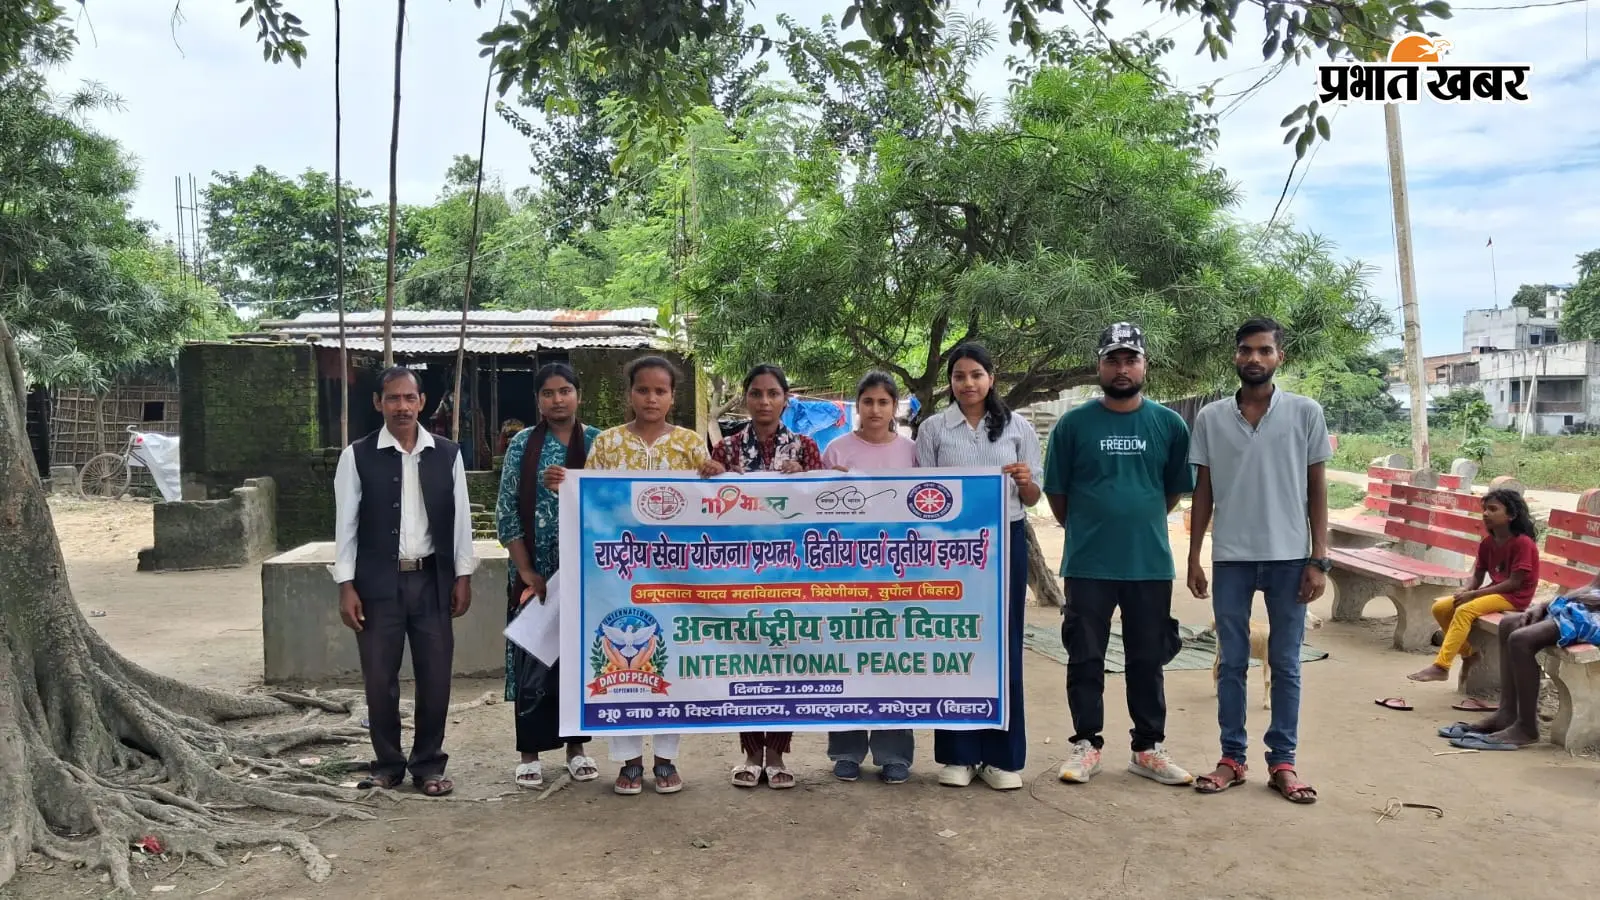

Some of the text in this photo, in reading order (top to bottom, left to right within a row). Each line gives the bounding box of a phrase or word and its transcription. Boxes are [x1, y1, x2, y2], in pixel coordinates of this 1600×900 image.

[1100, 439, 1147, 451] FREEDOM
[594, 528, 989, 578] राष्ट्रीय सेवा योजना प्रथम, द्वितीय एवं तृतीय इकाई
[635, 582, 961, 603] अनूपलाल यादव महाविद्यालय, त्रिवेणीगंज, सुपौल (बिहार)
[673, 607, 982, 648] अन्तर्राष्ट्रीय शांति दिवस
[678, 651, 975, 679] INTERNATIONAL PEACE DAY
[600, 672, 660, 687] DAY OF PEACE
[785, 684, 843, 694] 21.09.2026
[685, 702, 790, 718] विश्वविद्यालय,
[795, 702, 873, 718] लालूनगर,
[878, 700, 931, 717] मधेपुरा
[936, 699, 993, 717] (बिहार)
